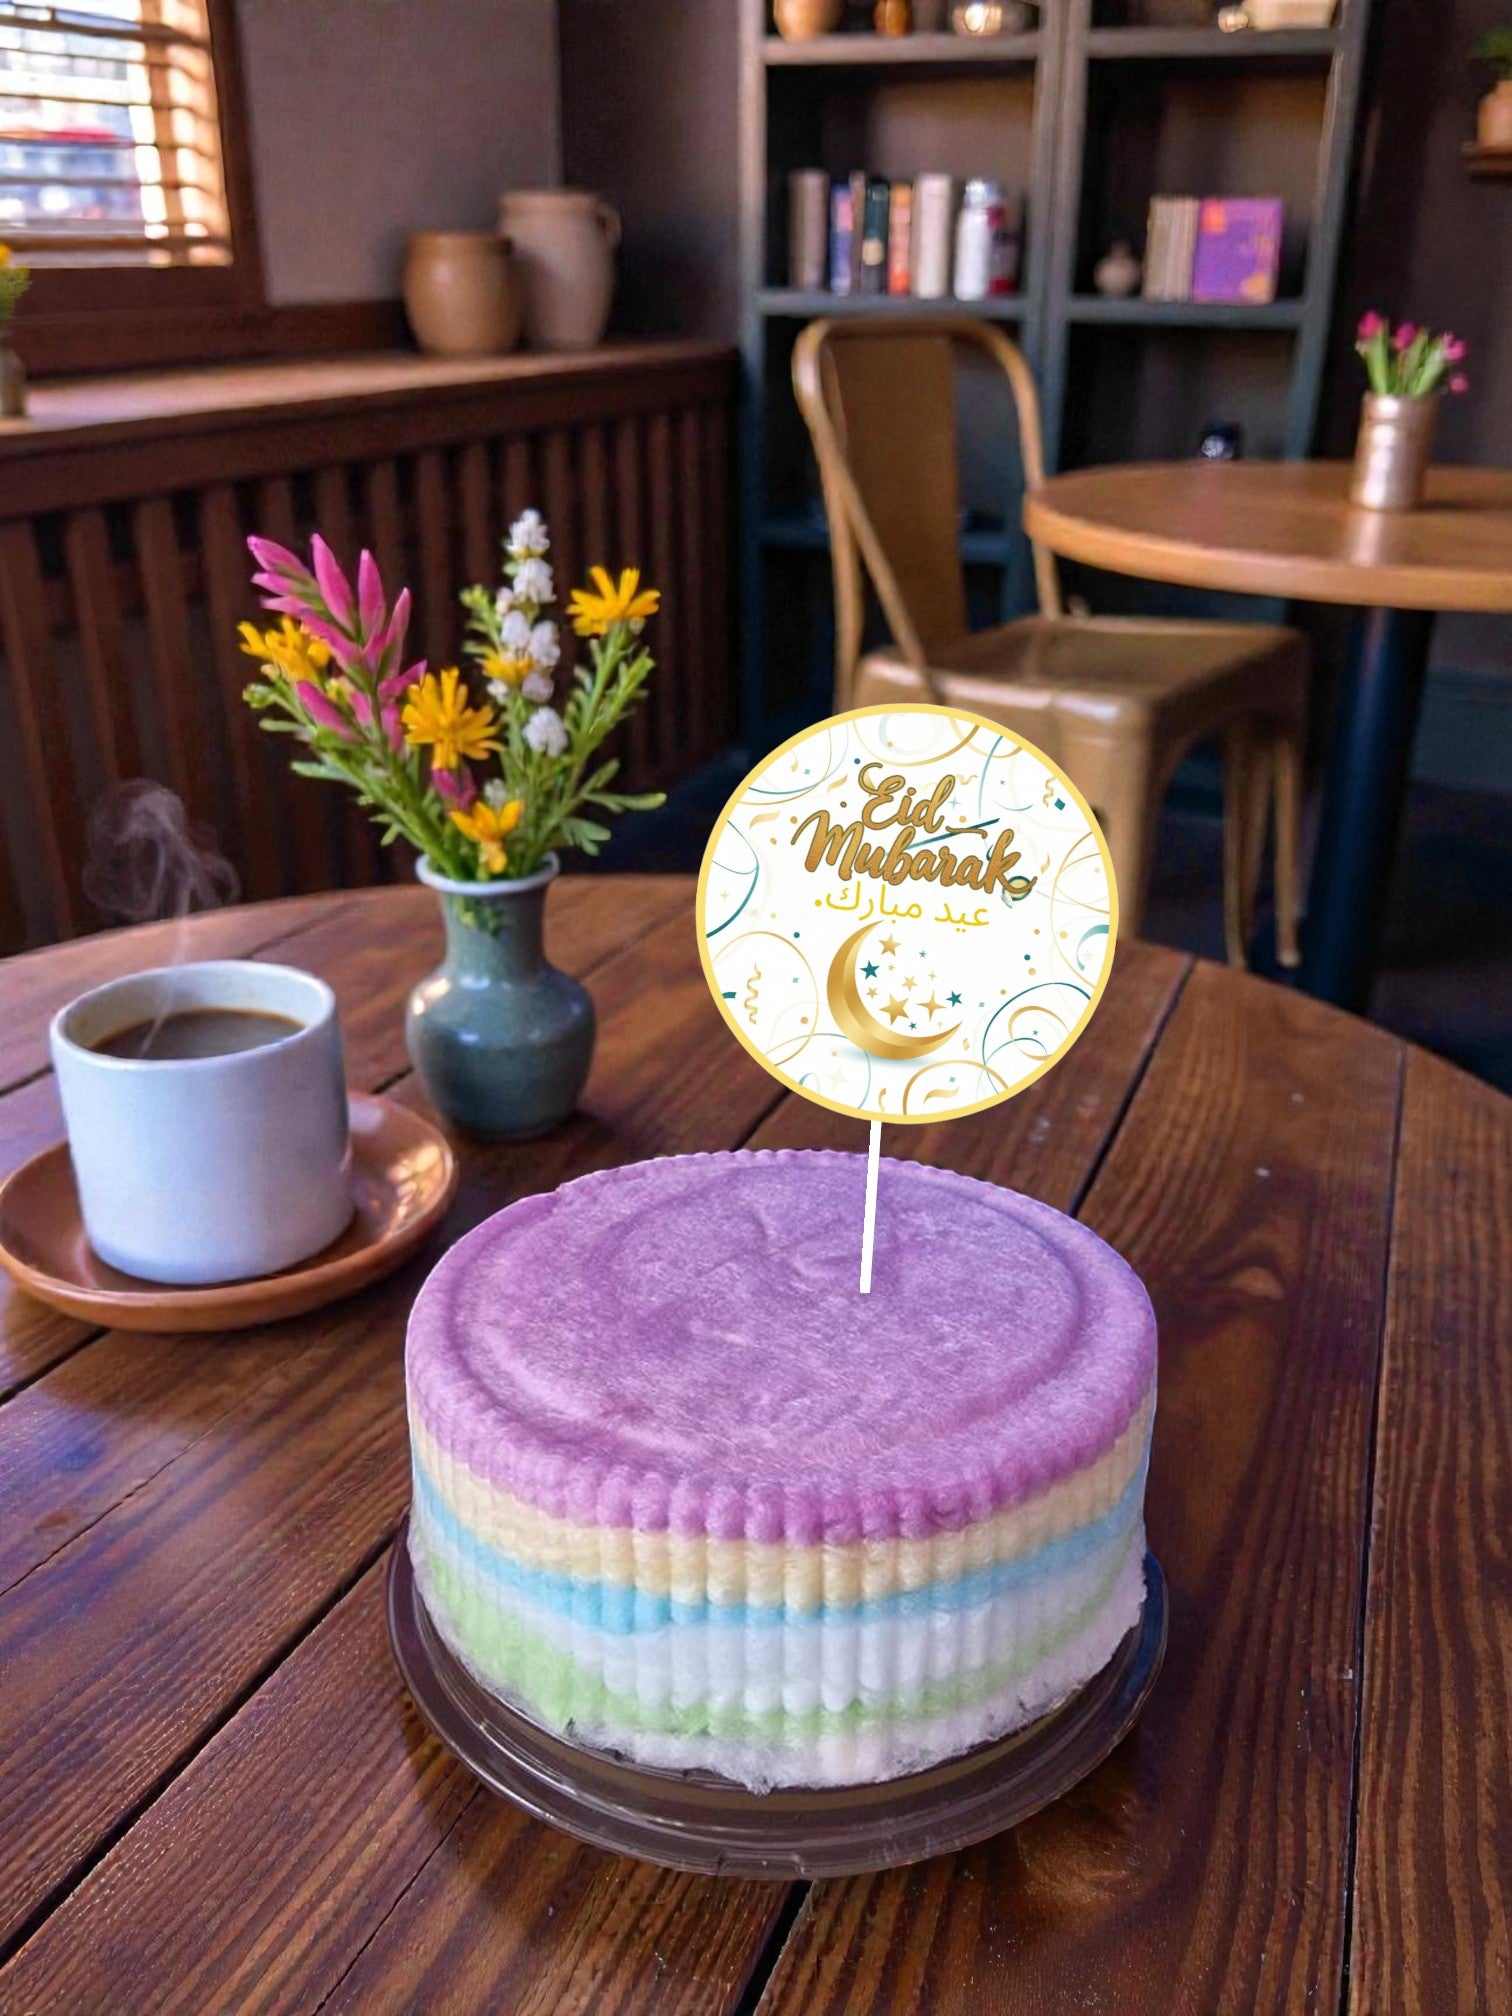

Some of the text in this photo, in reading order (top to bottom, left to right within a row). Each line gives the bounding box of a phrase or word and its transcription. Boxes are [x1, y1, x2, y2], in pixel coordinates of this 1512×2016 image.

[858, 762, 955, 833] Eid
[790, 810, 1038, 894] Mubarak
[934, 903, 990, 933] عيد
